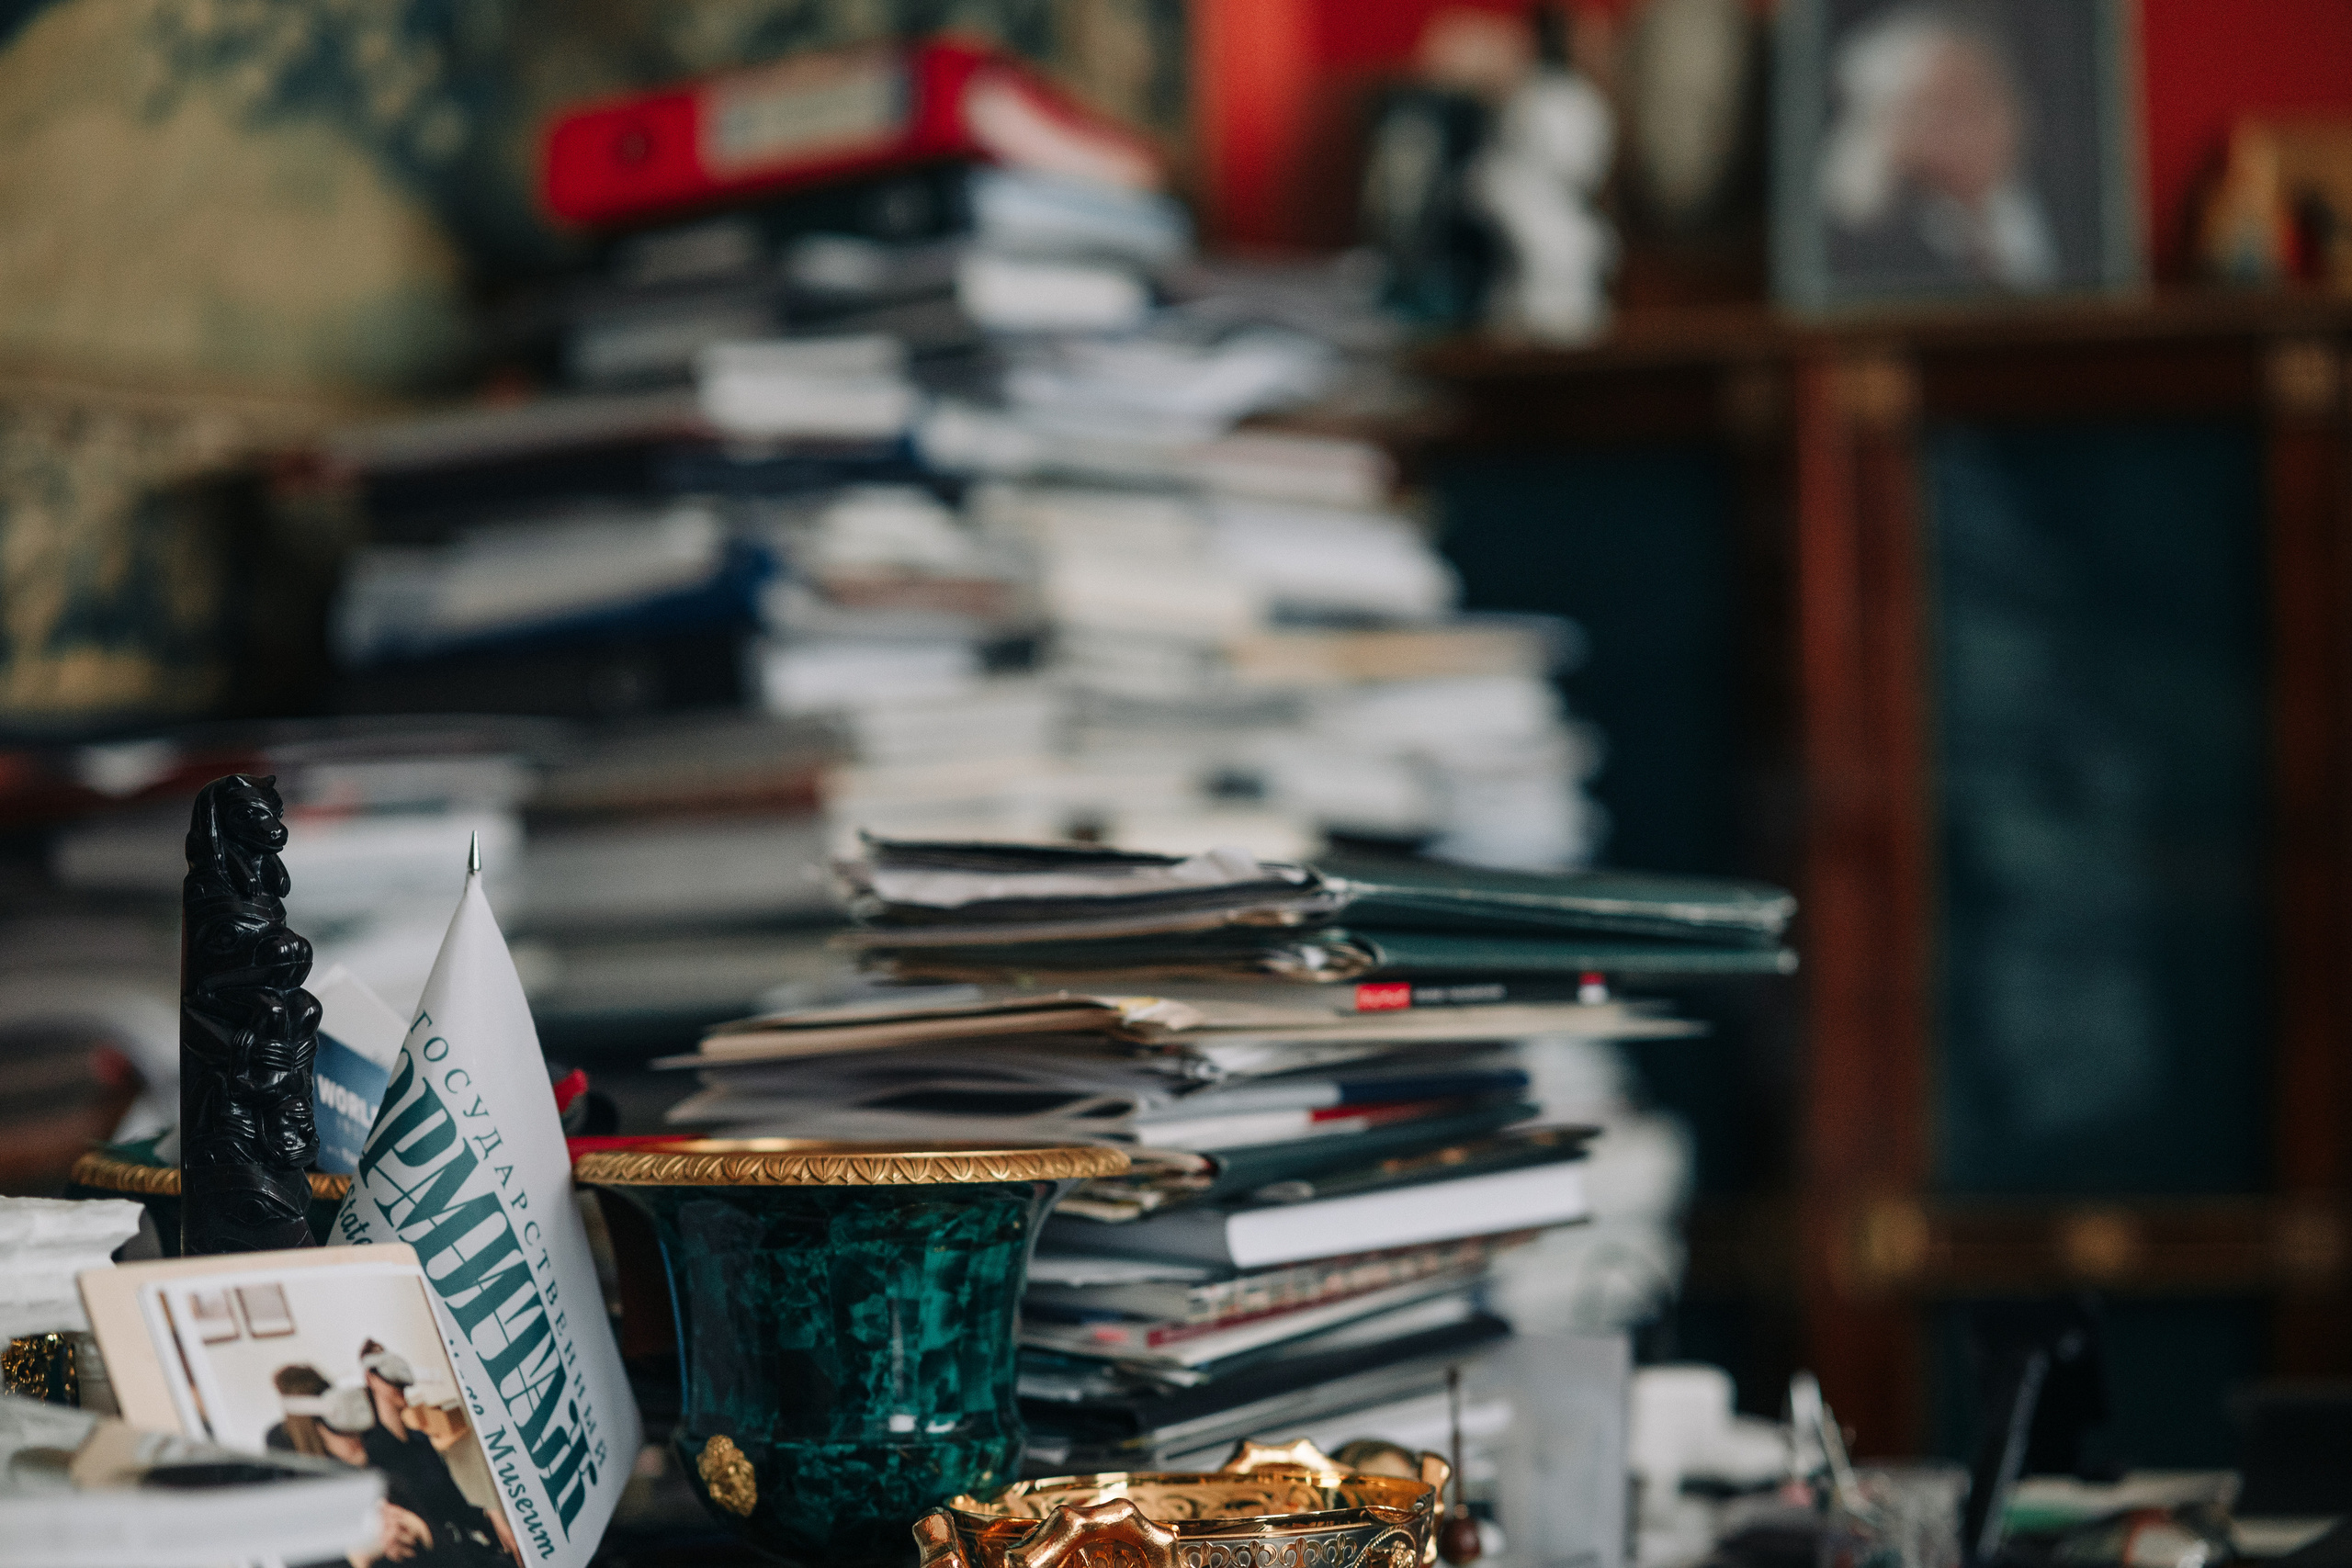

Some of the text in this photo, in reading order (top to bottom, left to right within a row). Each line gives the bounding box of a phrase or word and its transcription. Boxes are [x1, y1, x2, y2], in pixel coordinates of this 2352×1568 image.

[338, 1184, 373, 1246] Stat
[410, 1010, 607, 1467] ГОСУДАРСТВЕННЫЙ
[484, 1424, 555, 1560] Museum
